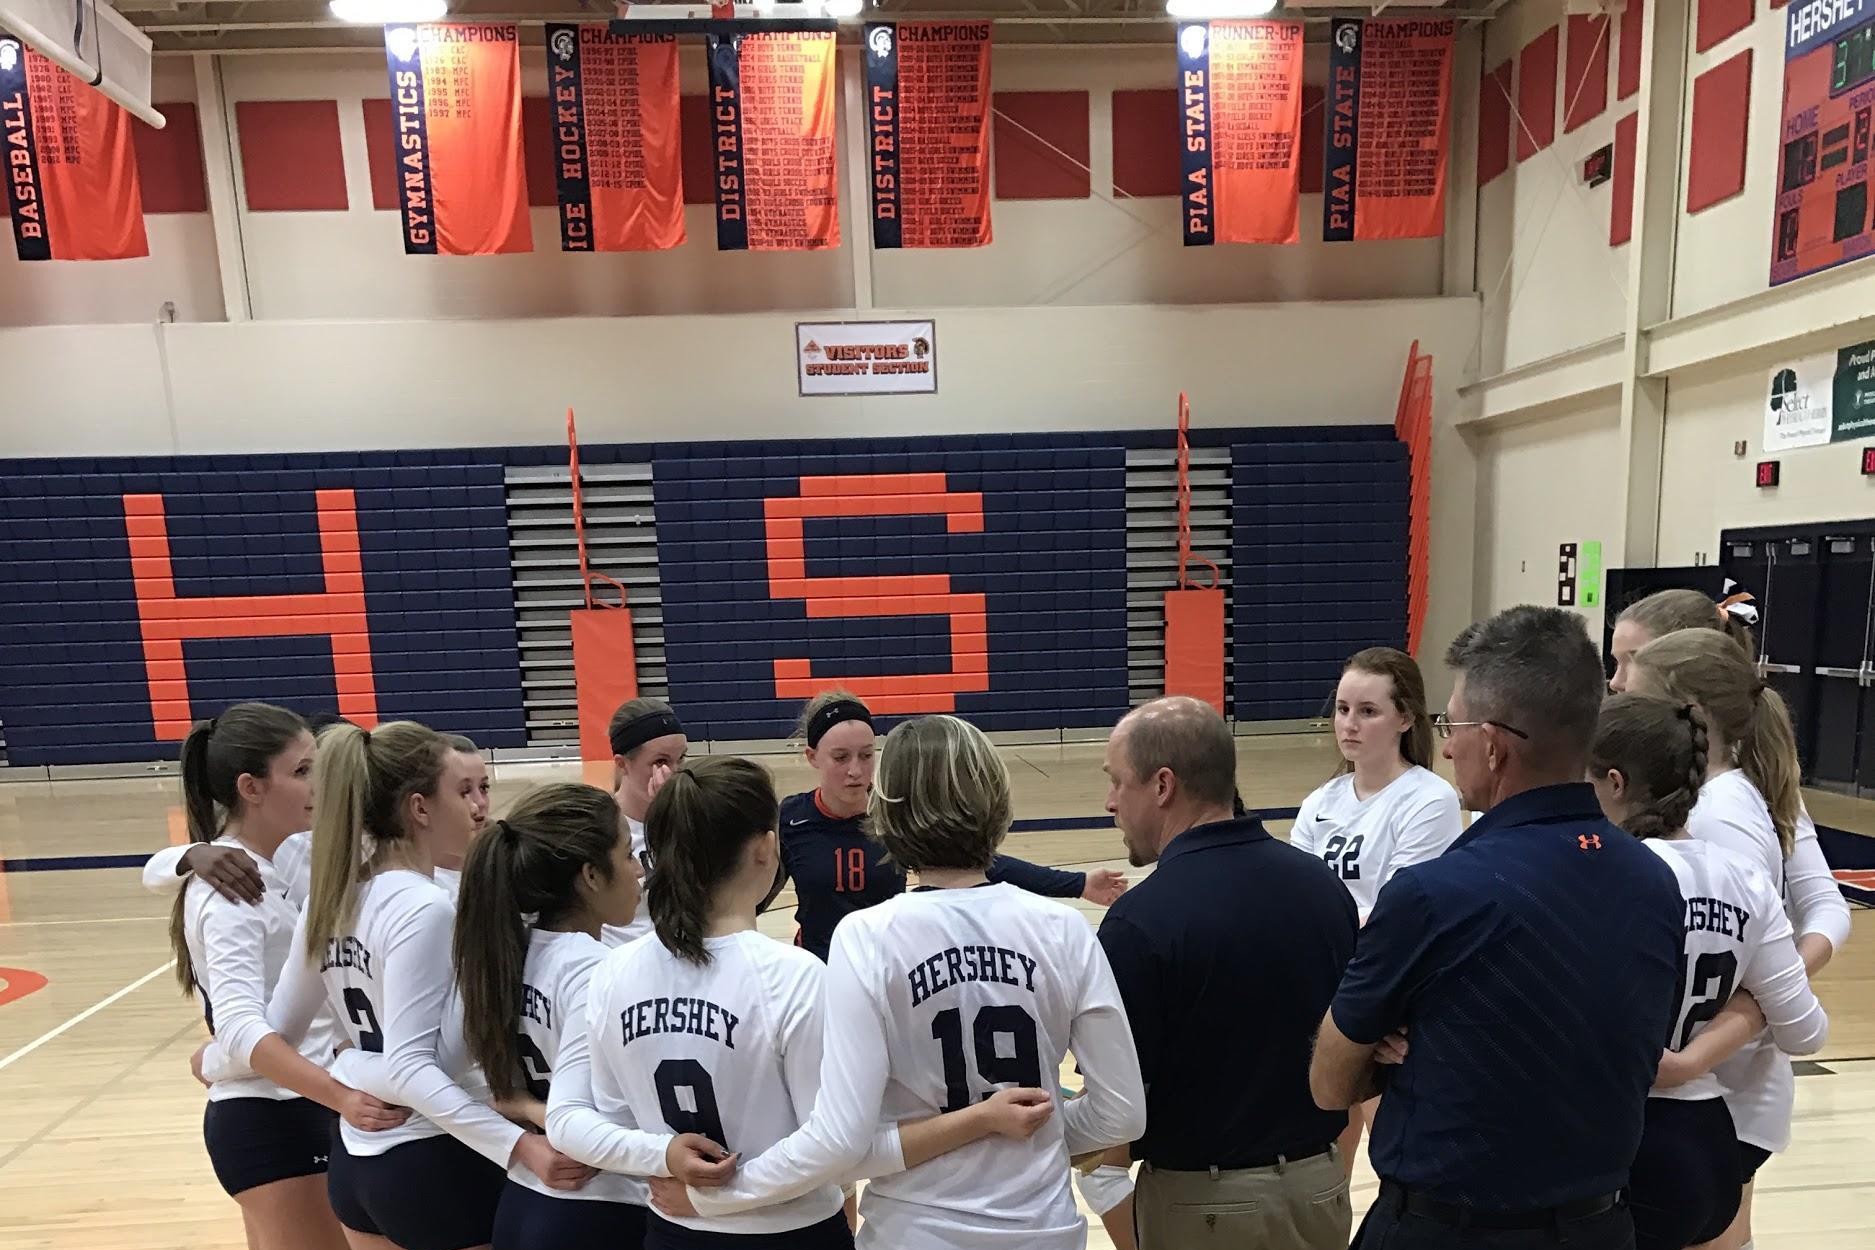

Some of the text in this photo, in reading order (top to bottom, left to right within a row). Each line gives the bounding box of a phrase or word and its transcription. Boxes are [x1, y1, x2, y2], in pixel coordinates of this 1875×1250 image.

[421, 25, 516, 43] CHAMPIONS
[581, 28, 676, 44] CHAMPIONS
[899, 25, 989, 41] CHAMPIONS
[1213, 25, 1300, 41] RUNNER-UP
[1365, 21, 1453, 38] CHAMPIONS
[1790, 0, 1863, 47] HERSHE
[1786, 105, 1819, 138] HOME
[3, 93, 42, 239] BASEBALL
[396, 71, 430, 245] GYMNASTICS
[555, 65, 587, 250] ICE HOCKEY
[715, 86, 740, 220] DISTRICT
[873, 86, 896, 219] DISTRICT
[1185, 70, 1208, 234] PIAA STATE
[1330, 65, 1355, 230] PIAA STATE
[805, 361, 929, 376] STUDENT SECTION
[824, 344, 909, 361] VISITORS
[122, 472, 991, 742] H S
[834, 847, 865, 892] 18
[1323, 834, 1365, 880] 22
[908, 945, 1037, 1008] HERSHEY
[620, 997, 740, 1050] HERSHEY
[931, 1004, 1042, 1114] 19
